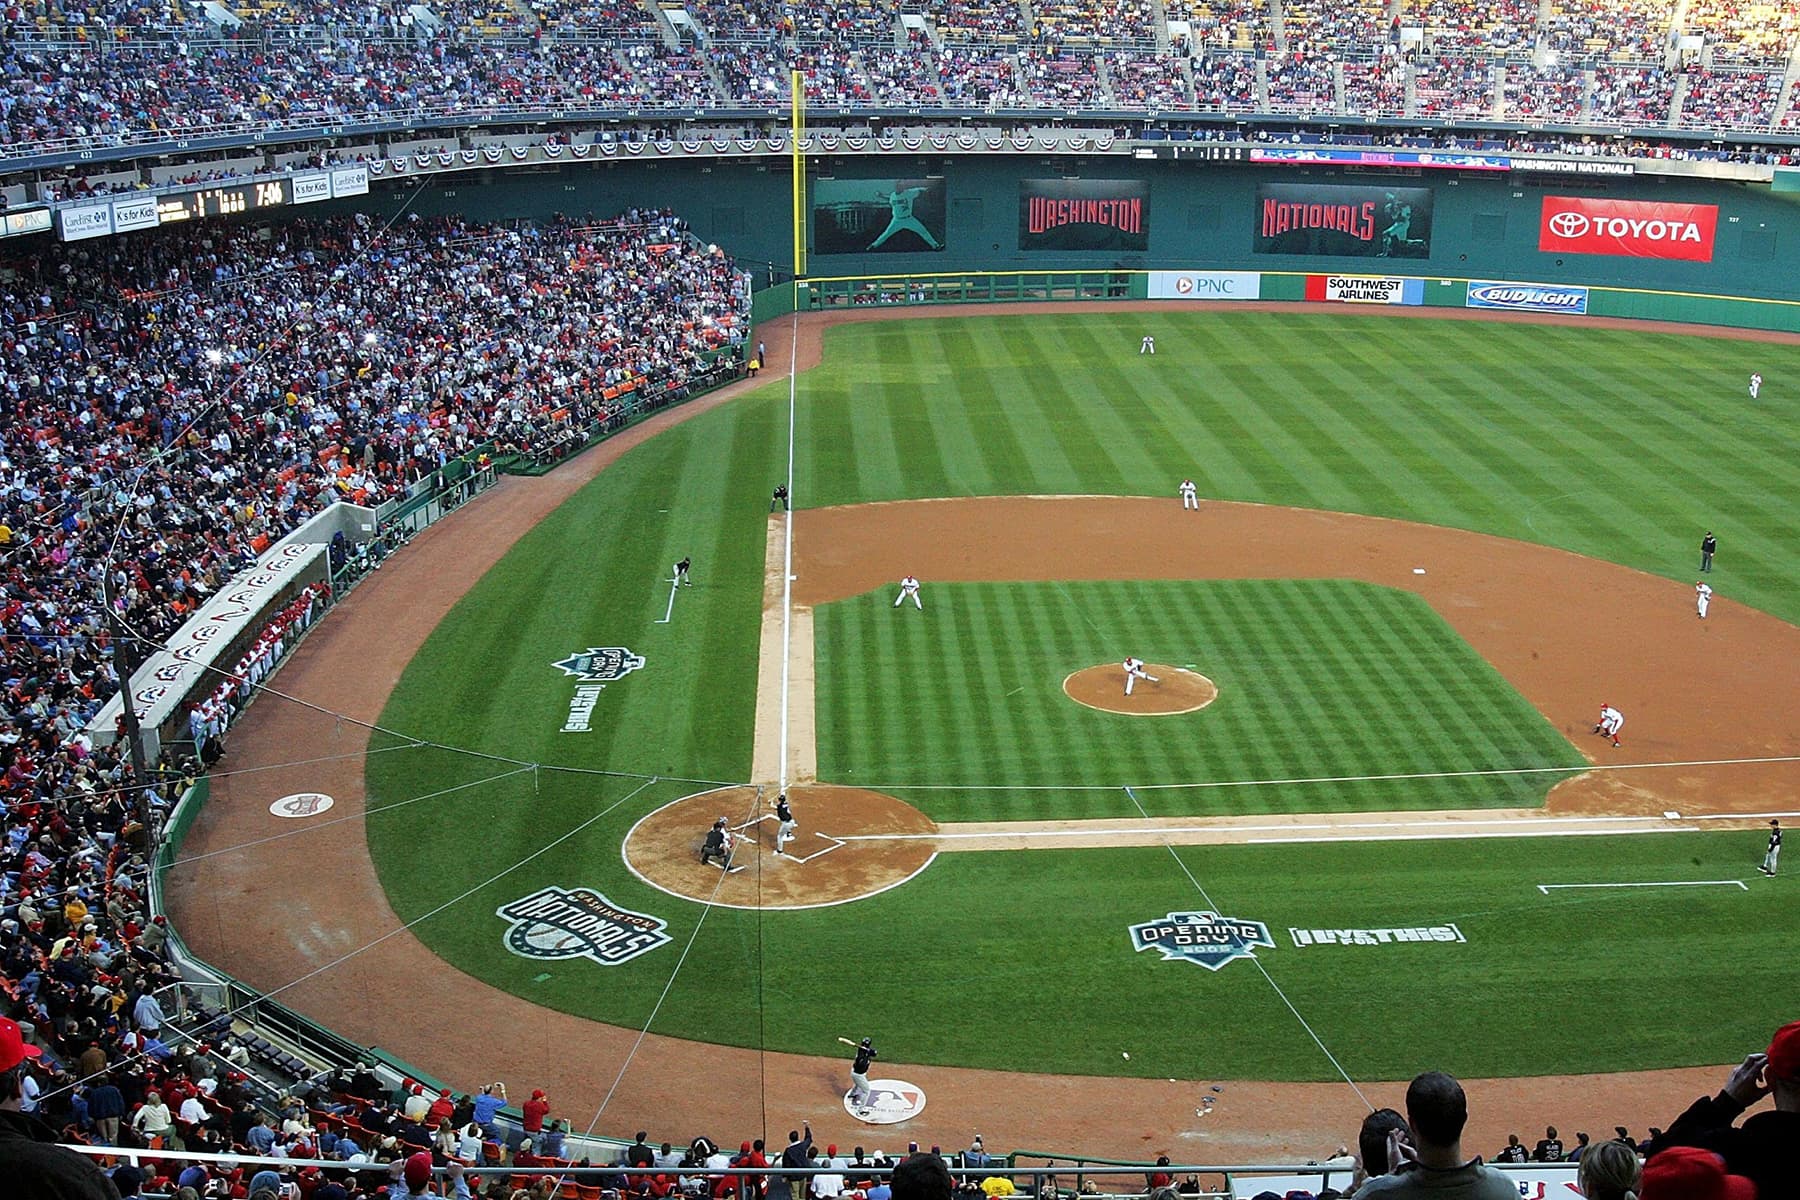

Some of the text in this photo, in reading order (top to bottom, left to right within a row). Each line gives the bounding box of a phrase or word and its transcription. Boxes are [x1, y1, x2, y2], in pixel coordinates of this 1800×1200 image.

[1510, 159, 1634, 175] WASHINGTON NATIONALS
[257, 182, 283, 206] 7:06
[305, 184, 314, 192] for
[315, 182, 327, 191] Kids
[129, 209, 138, 219] for
[139, 207, 154, 218] Kids
[1028, 198, 1142, 233] WASHINGTON
[1262, 199, 1375, 241] NATIONALS
[1593, 217, 1701, 242] TOYOTA
[1197, 279, 1234, 293] PNC
[1329, 279, 1400, 291] SOUTHWEST
[1338, 290, 1389, 300] AIRLINES
[1487, 290, 1582, 306] BUD LIGHT
[594, 650, 621, 678] OPENING
[576, 892, 655, 928] WASHINGTON
[509, 893, 655, 959] NATIONALS
[1141, 925, 1259, 941] OPENING
[1175, 934, 1229, 944] DAY
